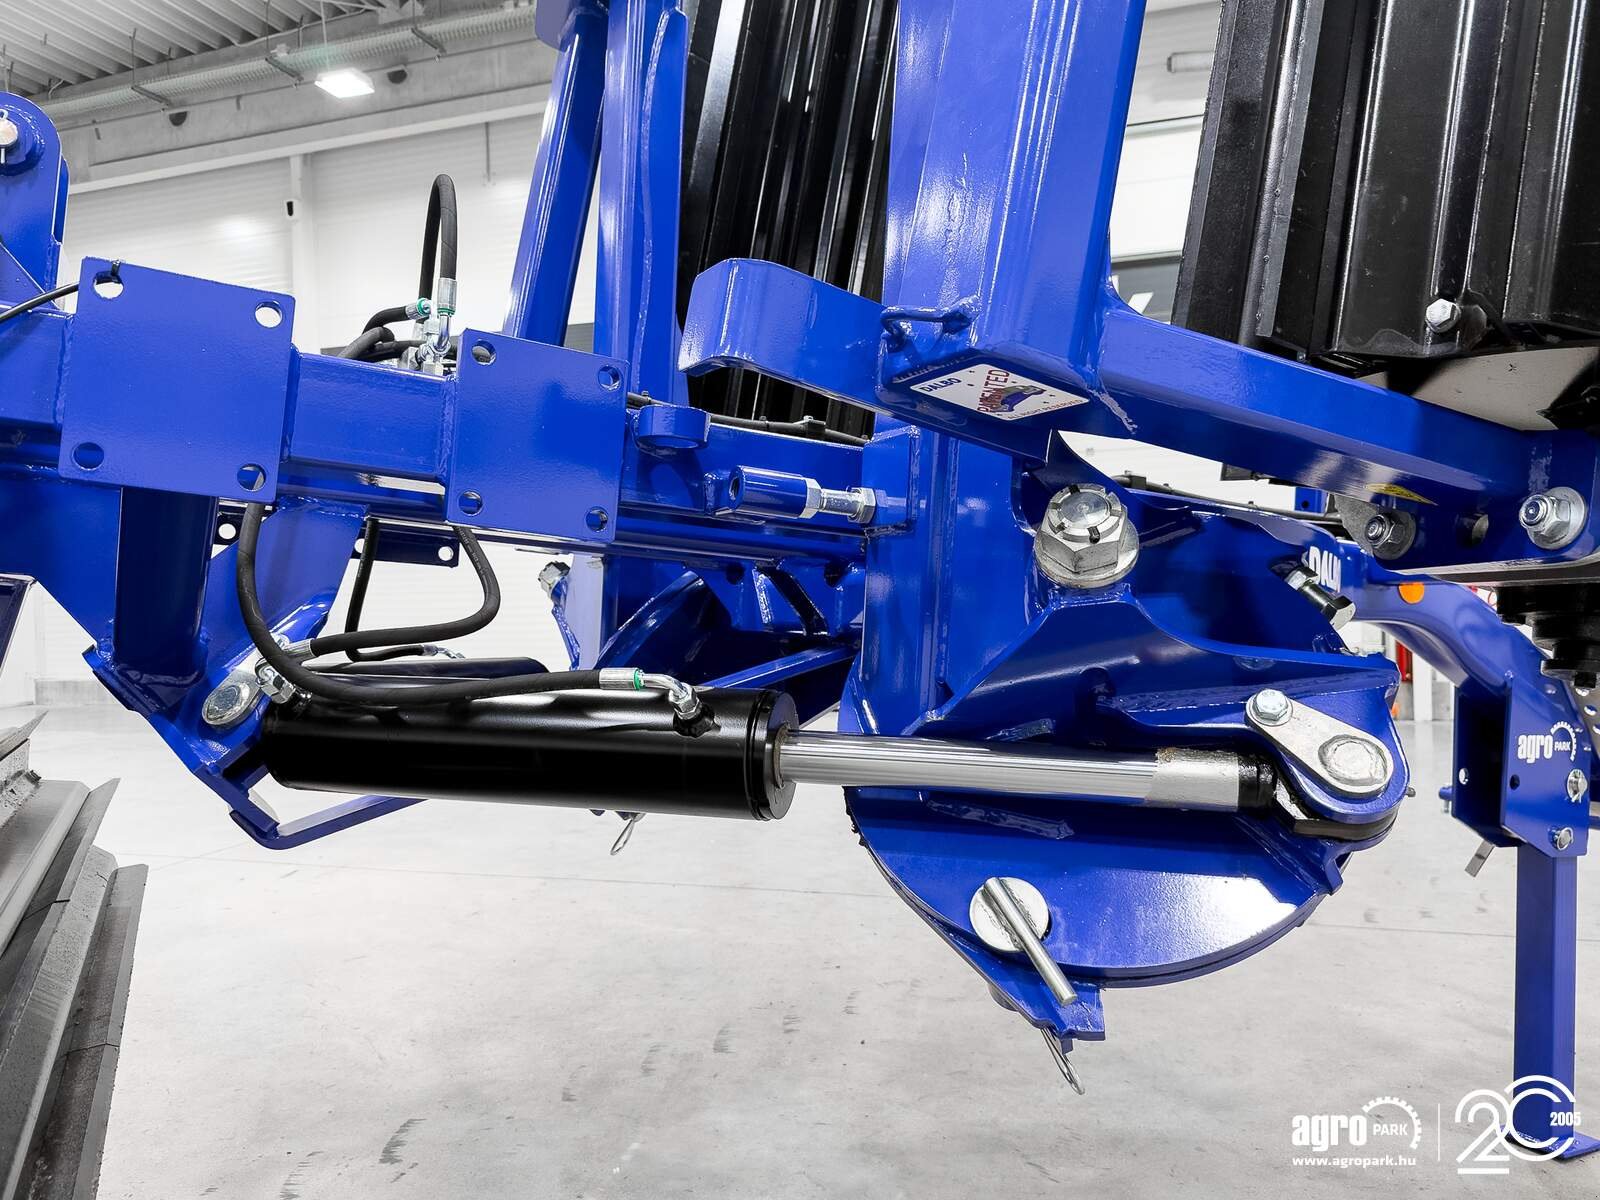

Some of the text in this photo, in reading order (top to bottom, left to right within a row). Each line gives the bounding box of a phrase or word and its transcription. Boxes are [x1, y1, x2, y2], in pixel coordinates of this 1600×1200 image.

[919, 377, 962, 392] DALBO
[1517, 734, 1571, 764] agro PARK
